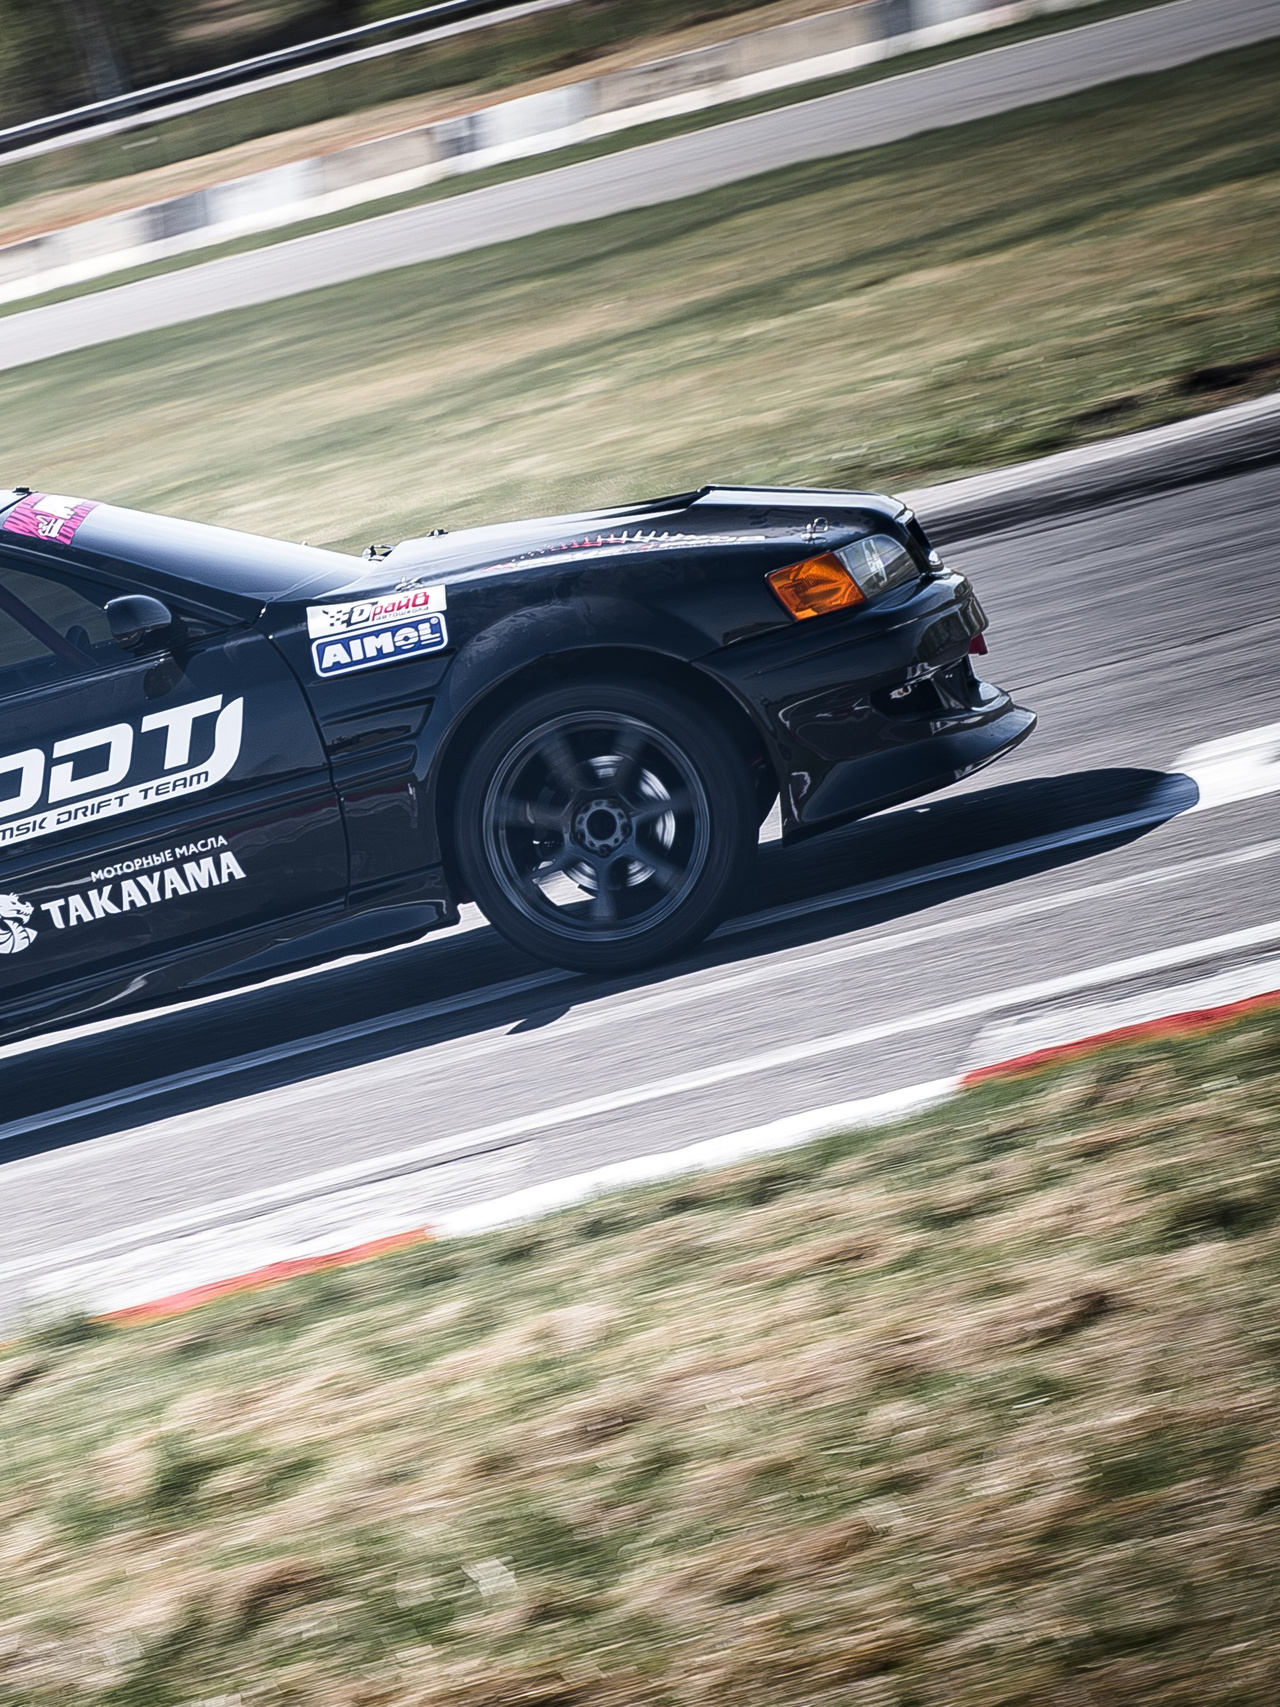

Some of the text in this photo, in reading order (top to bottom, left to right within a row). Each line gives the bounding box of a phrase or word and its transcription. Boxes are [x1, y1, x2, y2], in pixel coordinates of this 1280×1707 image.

[321, 621, 442, 669] AIMOL
[55, 793, 130, 826] DRIFT
[138, 770, 210, 801] TEAM
[91, 834, 228, 883] МОТОРНЫЕ МАСЛА
[40, 851, 247, 930] TAKAYAMA
